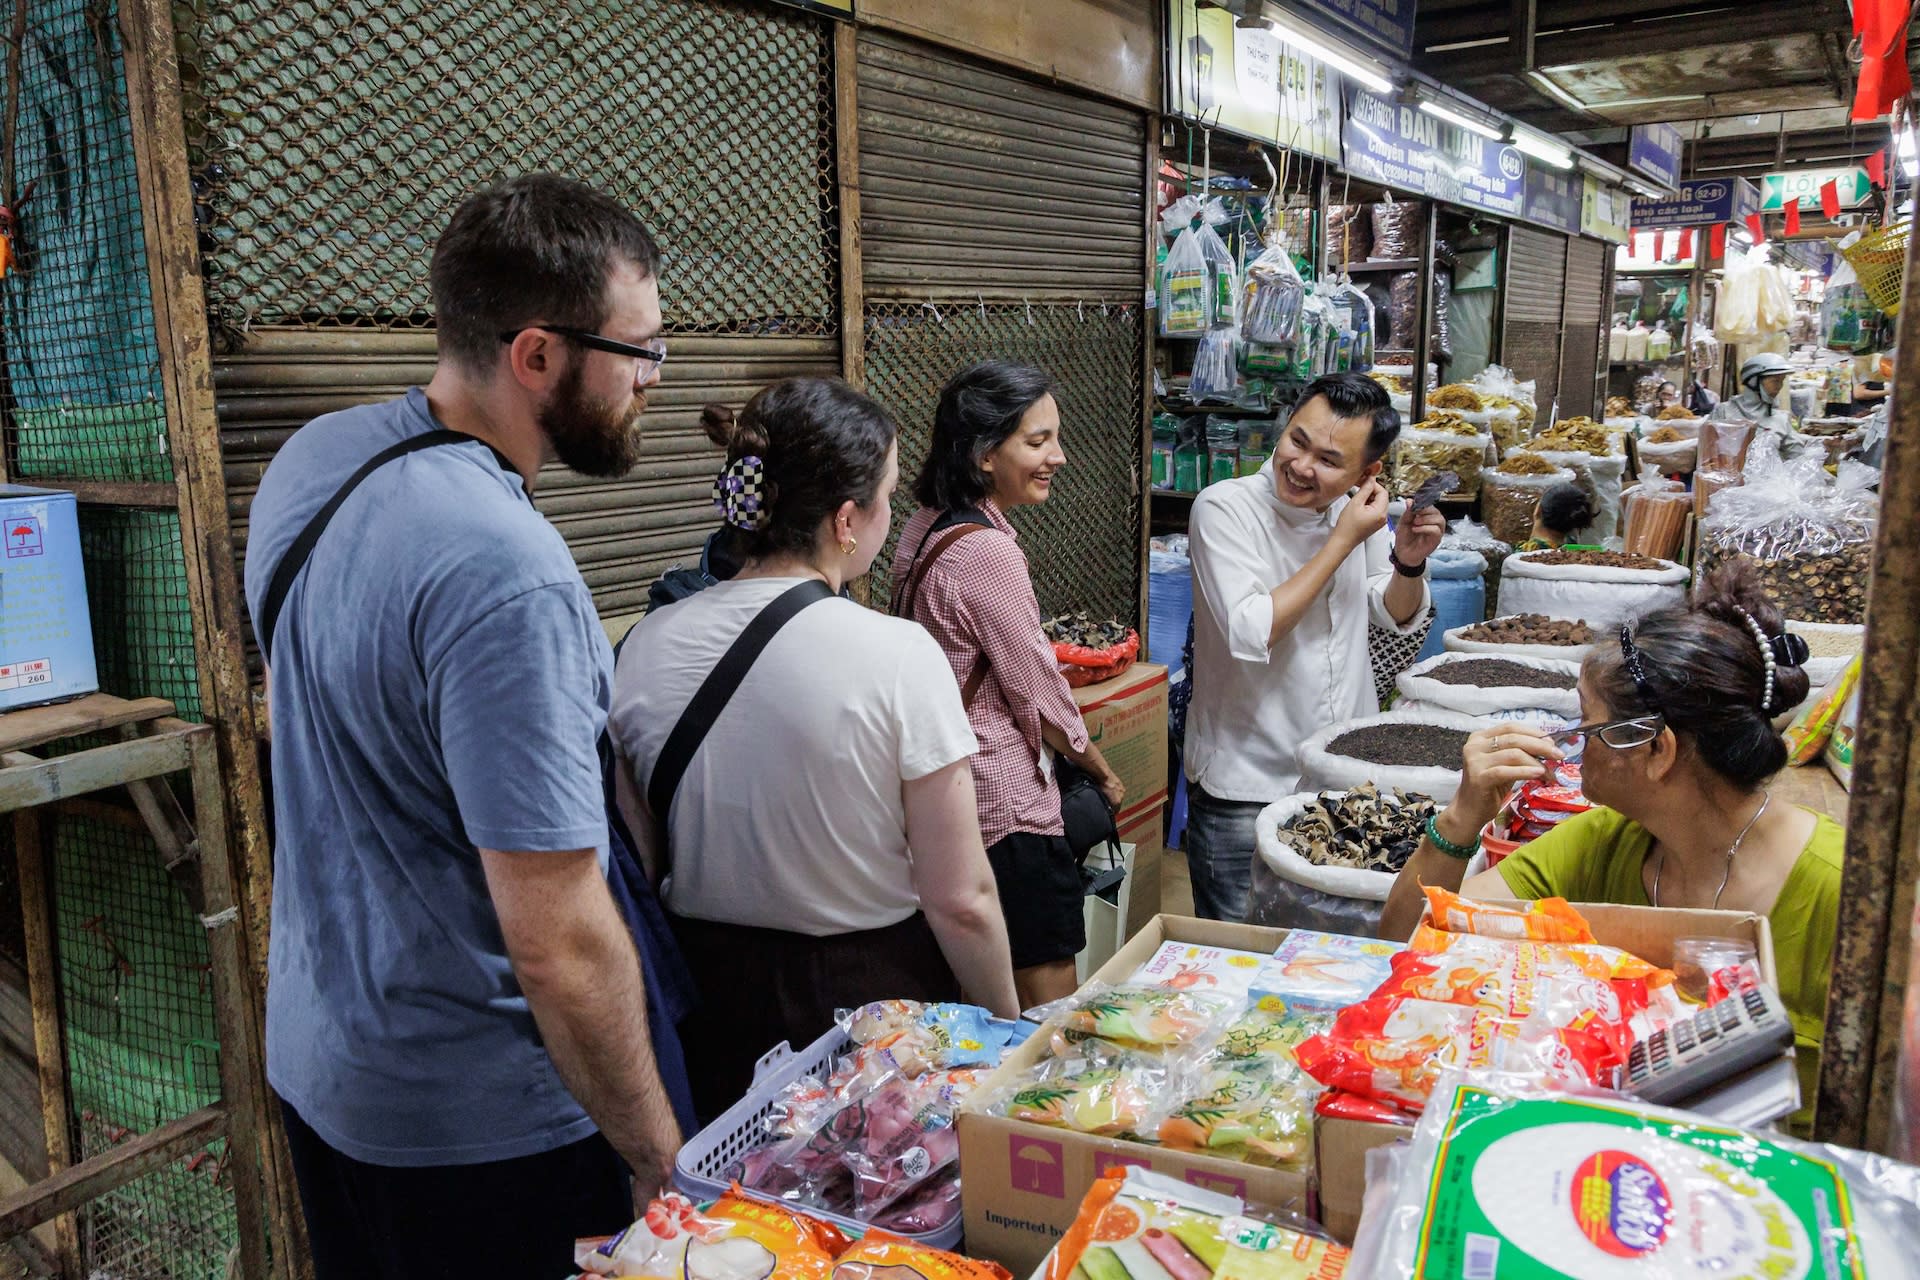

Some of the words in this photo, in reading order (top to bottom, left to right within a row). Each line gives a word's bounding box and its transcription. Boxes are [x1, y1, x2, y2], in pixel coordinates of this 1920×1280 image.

[1400, 106, 1439, 150] ĐAN
[27, 673, 46, 684] 260
[904, 1148, 926, 1173] Giang
[911, 1163, 924, 1176] Sa
[985, 1209, 1046, 1234] Imported
